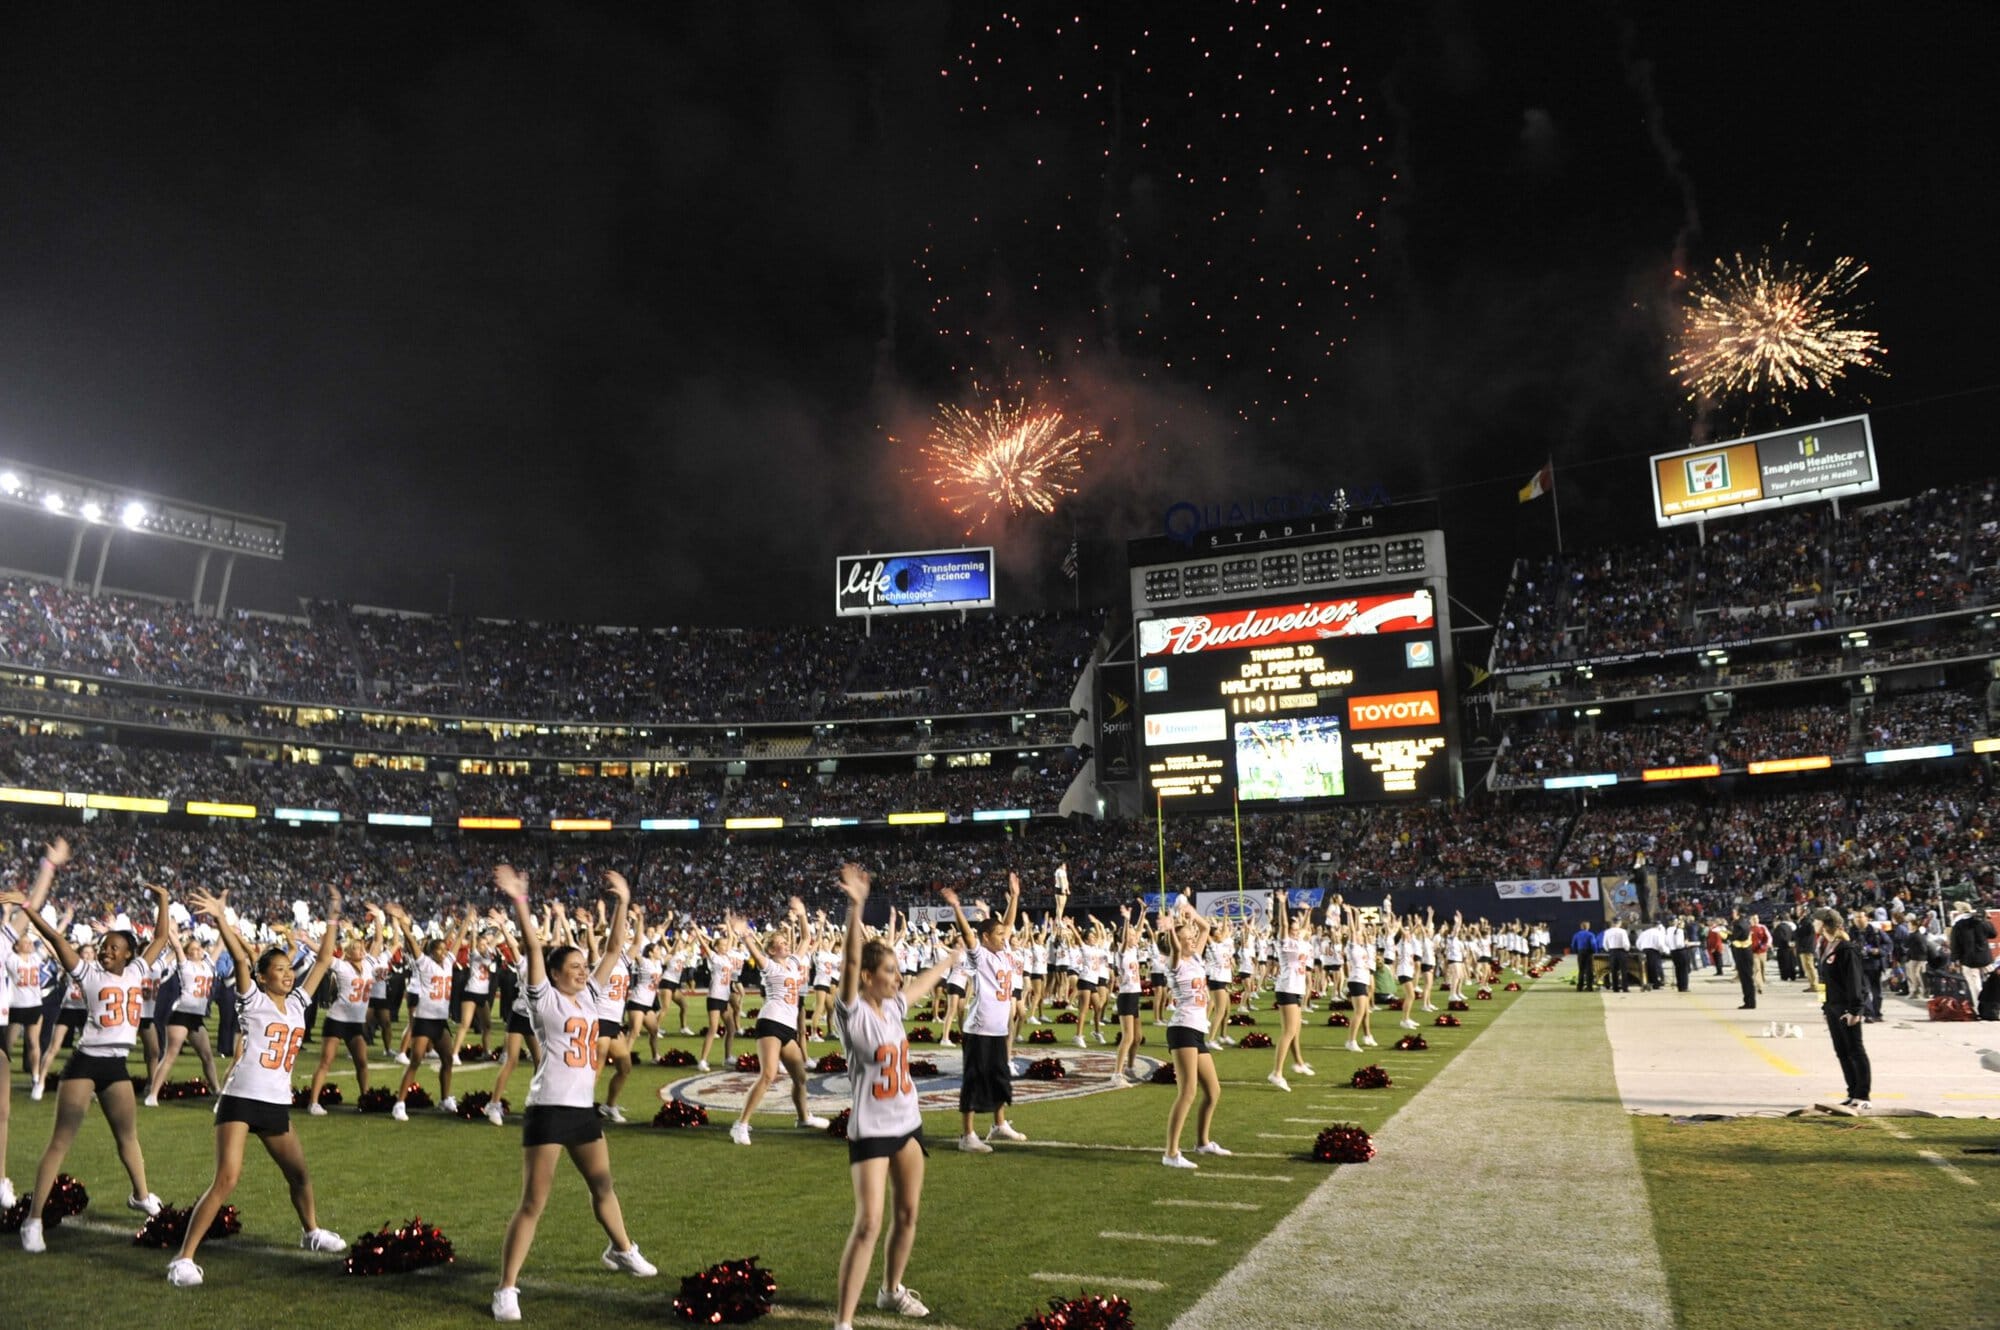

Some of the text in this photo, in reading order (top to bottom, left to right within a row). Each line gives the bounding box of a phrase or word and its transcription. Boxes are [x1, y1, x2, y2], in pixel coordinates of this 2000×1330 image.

[1763, 450, 1865, 476] Imaging Healthcare
[1771, 468, 1859, 491] Your Partner in Health
[1211, 515, 1374, 546] STADIM
[921, 561, 985, 574] Transforming
[935, 571, 971, 582] science
[841, 560, 891, 605] life
[1168, 600, 1359, 655] Budweiser
[1297, 645, 1314, 657] TO
[1241, 657, 1325, 678] DR PEPPER
[1221, 674, 1302, 695] HALFTIME
[1310, 669, 1353, 687] SHOW
[1353, 700, 1435, 722] TOYOTA
[1102, 720, 1132, 735] Sprint
[1568, 880, 1591, 899] N
[917, 908, 929, 921] A
[1359, 906, 1380, 923] 25
[17, 967, 40, 987] 36
[350, 978, 374, 1003] 36
[430, 976, 453, 1001] 36
[98, 986, 142, 1028] 36
[260, 1022, 305, 1073] 36
